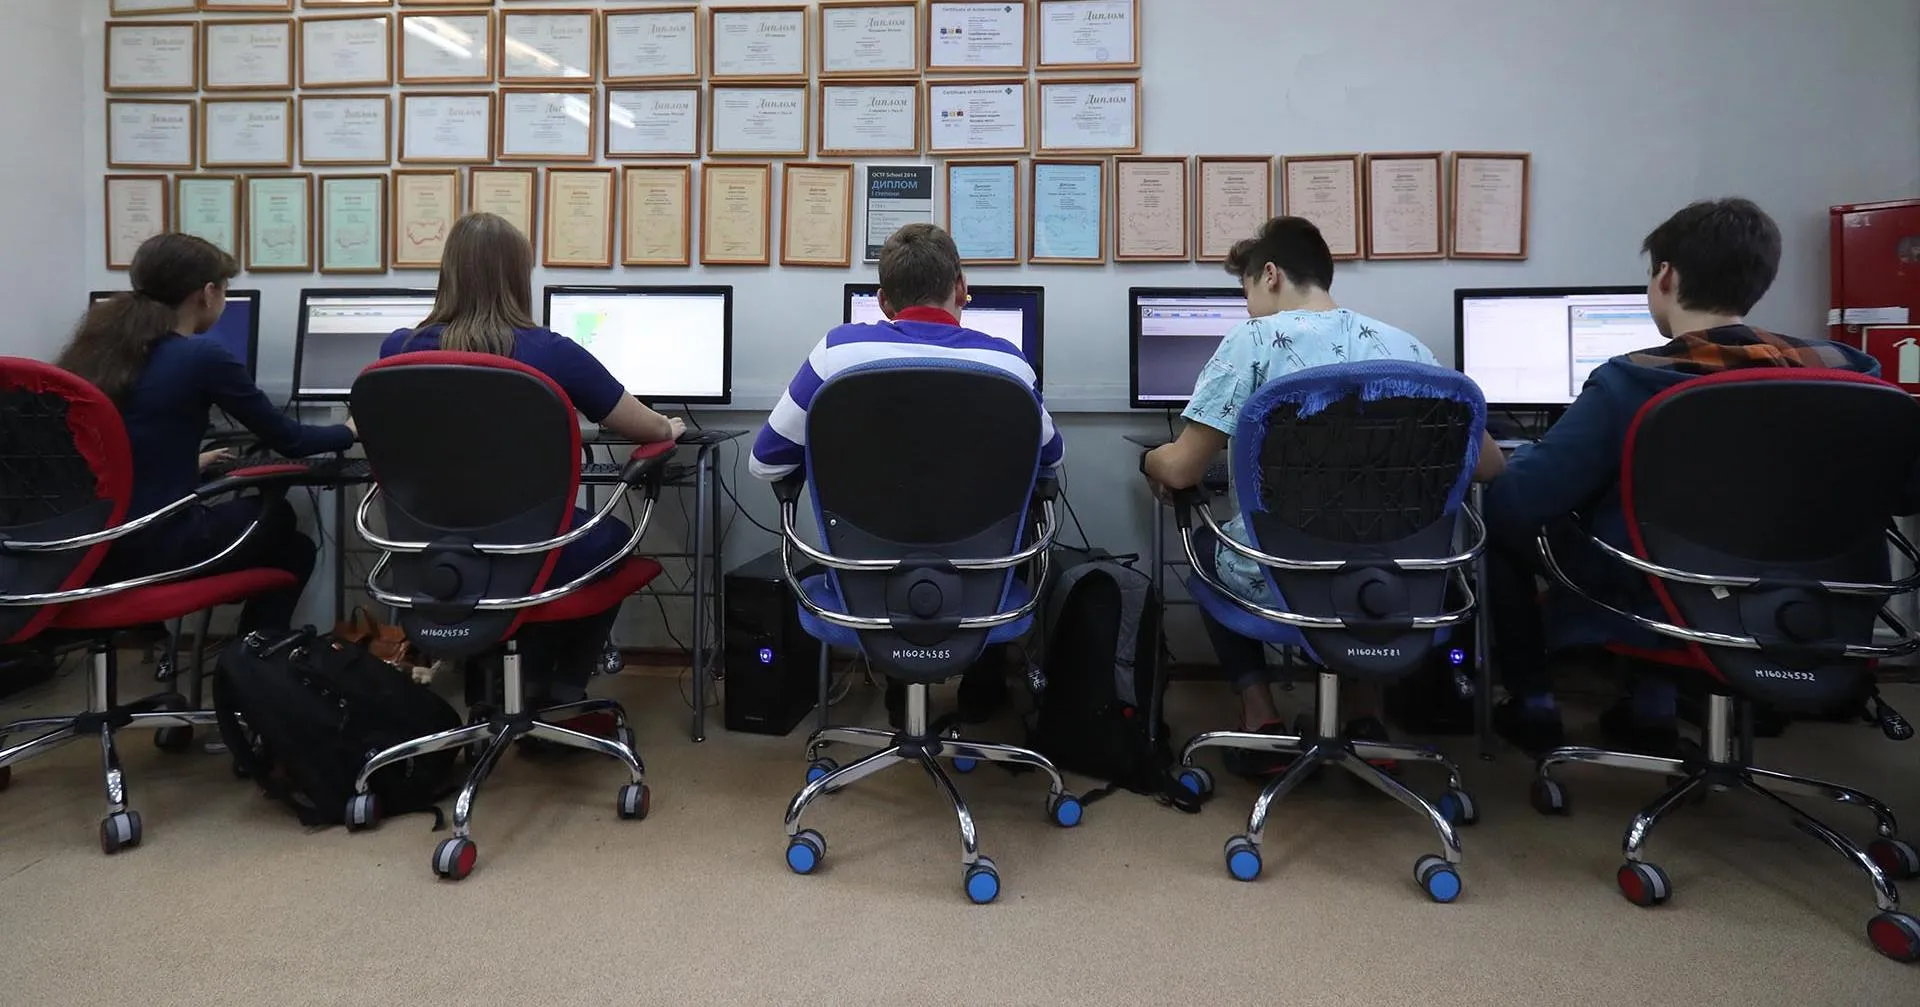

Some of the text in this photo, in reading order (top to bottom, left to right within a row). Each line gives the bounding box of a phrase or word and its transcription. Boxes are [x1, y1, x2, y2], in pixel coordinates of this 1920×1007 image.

[1083, 10, 1125, 20] Диплом
[756, 22, 796, 33] Диплом
[865, 17, 906, 28] Диплом
[756, 98, 797, 109] Диплом
[866, 96, 908, 107] Диплом
[1084, 94, 1127, 105] Диплом
[650, 101, 689, 111] Диплом
[871, 180, 918, 190] ДИПЛОМ
[892, 649, 951, 659] M16024585
[1347, 648, 1401, 657] M16024581
[1754, 669, 1816, 681] M16024592
